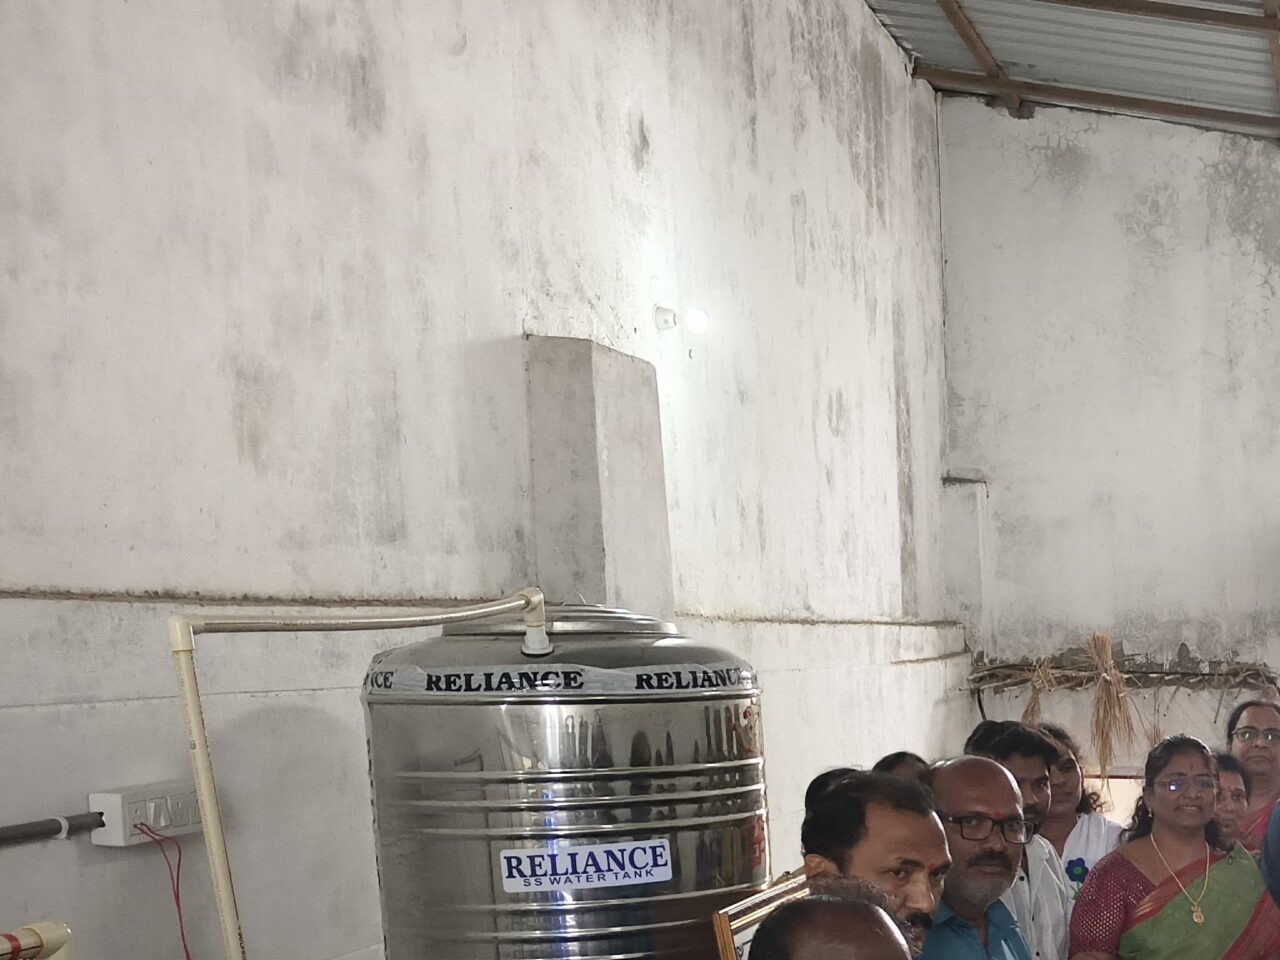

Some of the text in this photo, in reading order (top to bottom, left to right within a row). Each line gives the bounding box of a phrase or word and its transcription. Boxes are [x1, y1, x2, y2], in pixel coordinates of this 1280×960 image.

[425, 671, 585, 692] RELIANCE
[503, 844, 669, 879] RELIANCE
[523, 868, 655, 887] SS WATER TANK
